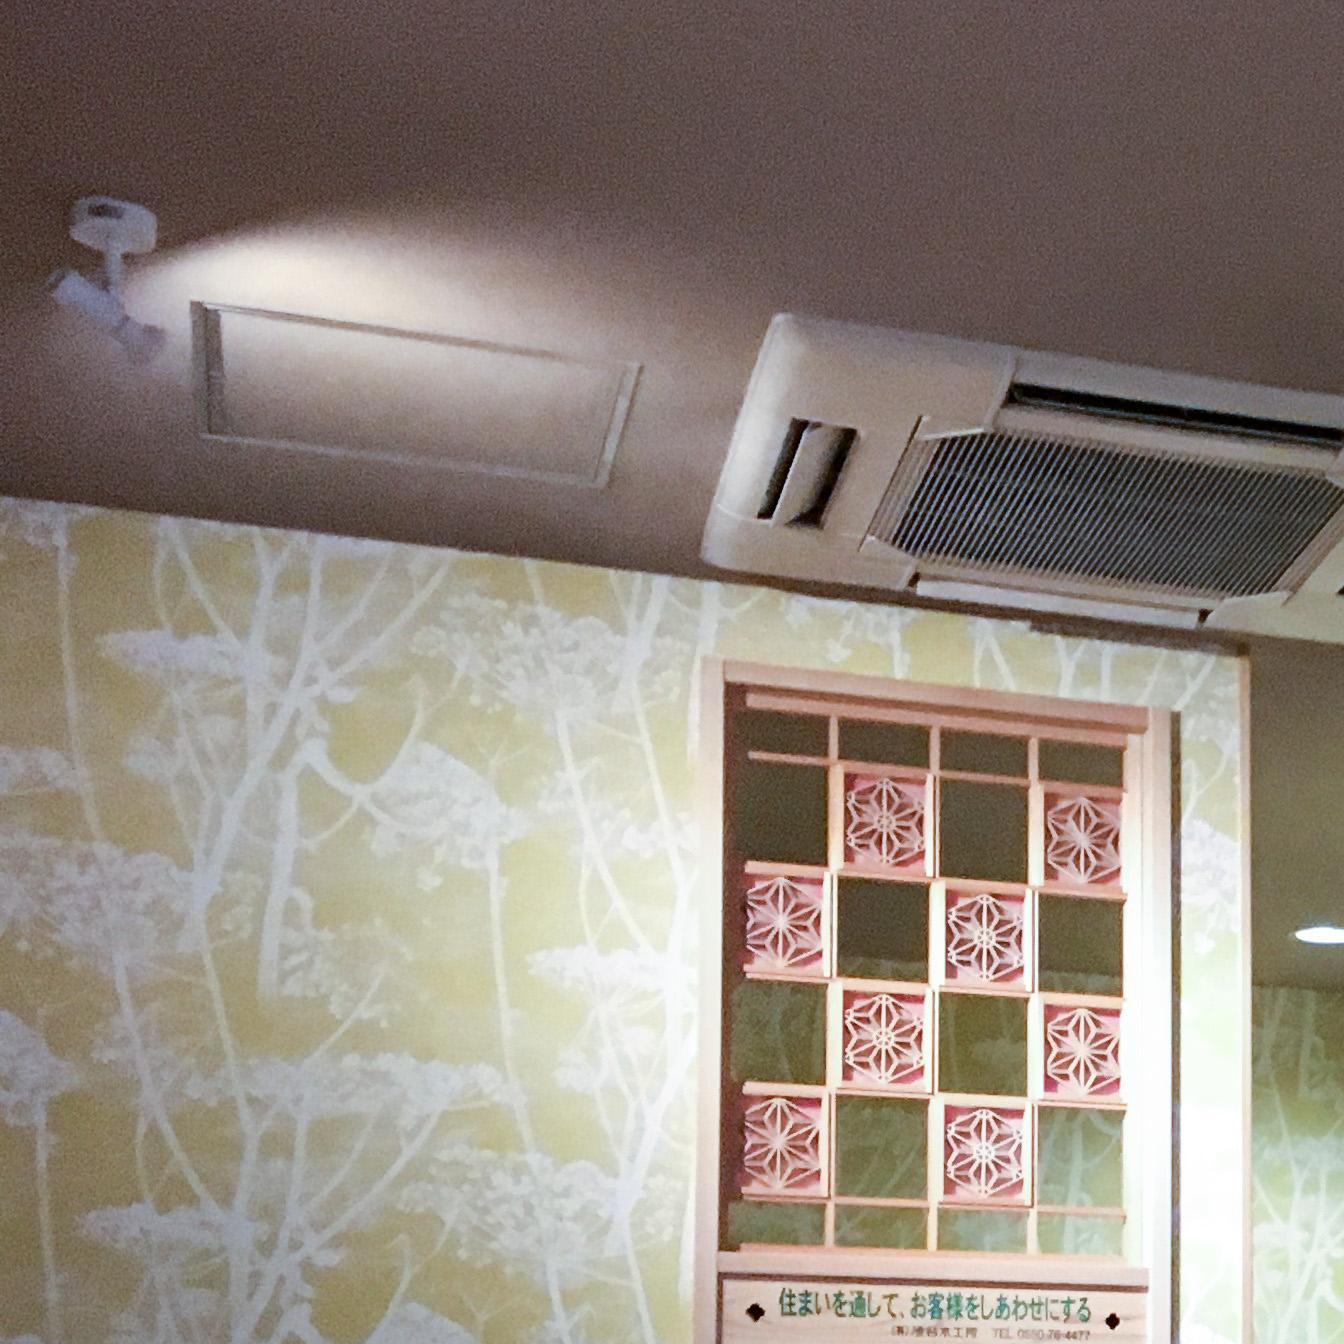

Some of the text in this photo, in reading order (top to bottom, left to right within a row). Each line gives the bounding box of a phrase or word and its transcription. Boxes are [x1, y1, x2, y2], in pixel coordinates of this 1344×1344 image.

[779, 1287, 1091, 1323] 住まいを通して、お客様をしあわせにする
